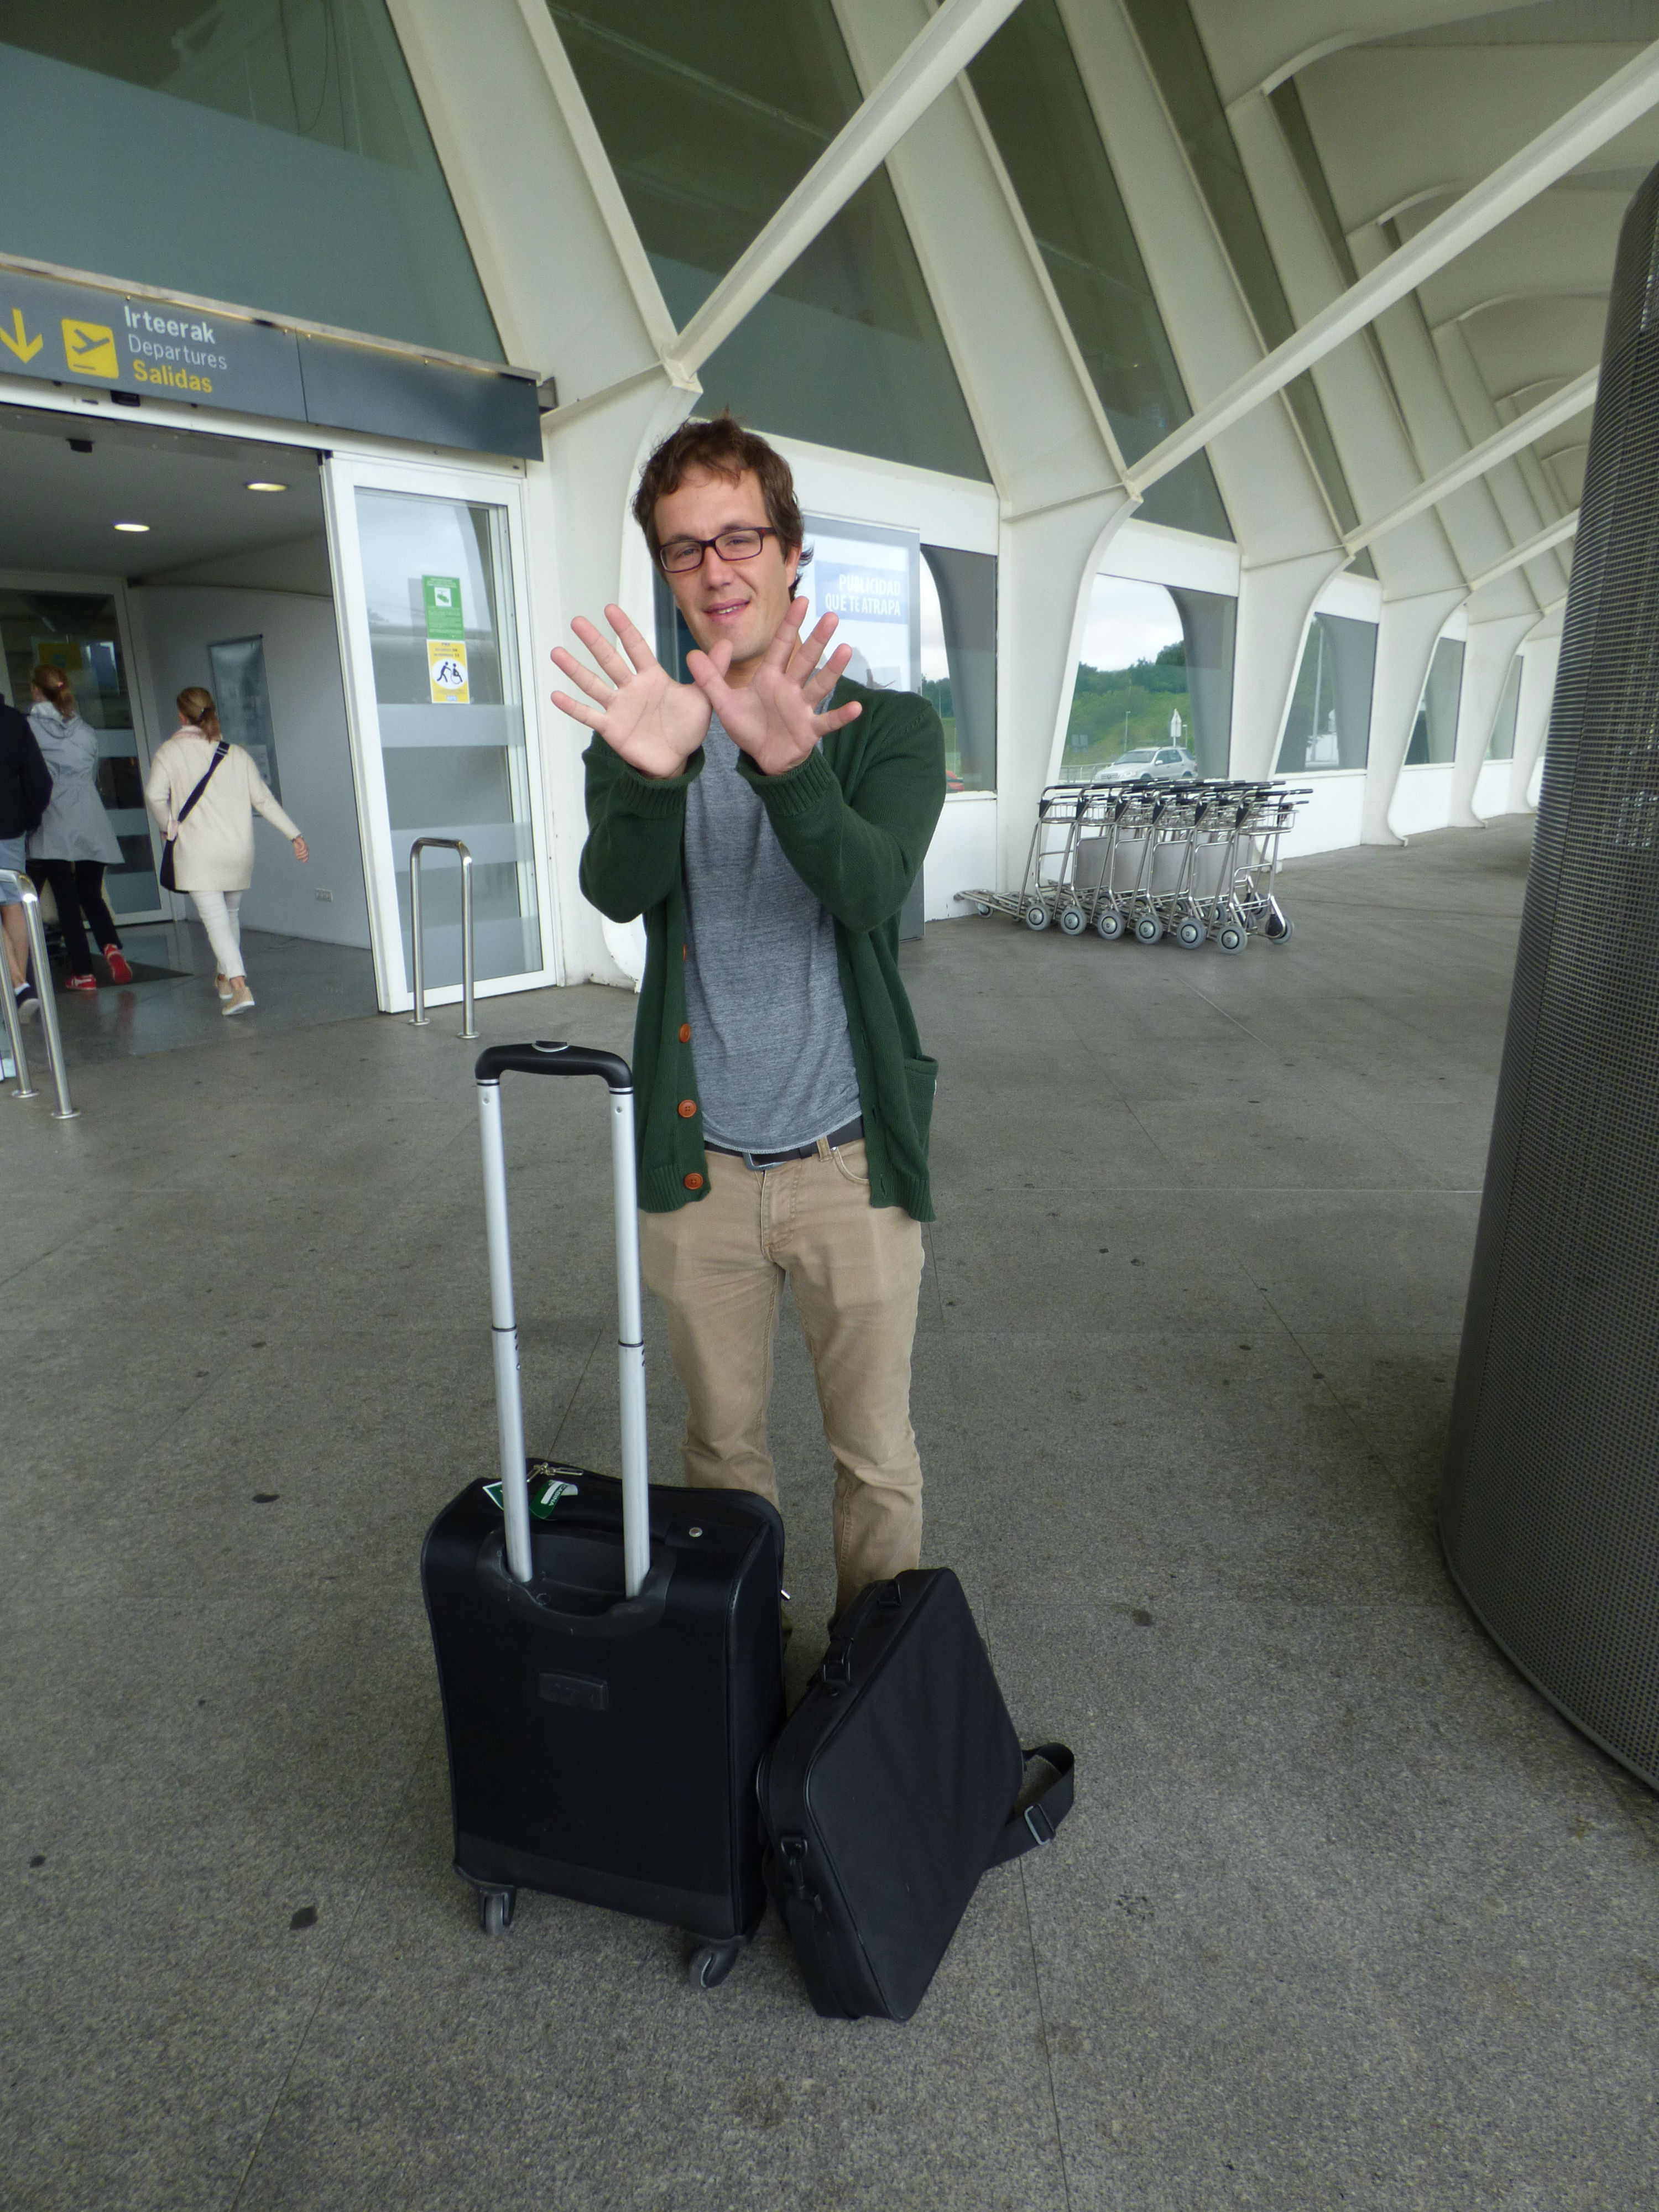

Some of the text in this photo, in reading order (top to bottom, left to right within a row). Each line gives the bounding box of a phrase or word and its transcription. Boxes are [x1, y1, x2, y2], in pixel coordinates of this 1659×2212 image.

[124, 305, 216, 344] Irteerak
[128, 333, 227, 369] Departures
[133, 359, 212, 393] Salidas
[839, 573, 901, 597] PUBLICIDAD
[825, 593, 901, 615] QUE TE ATRAPA
